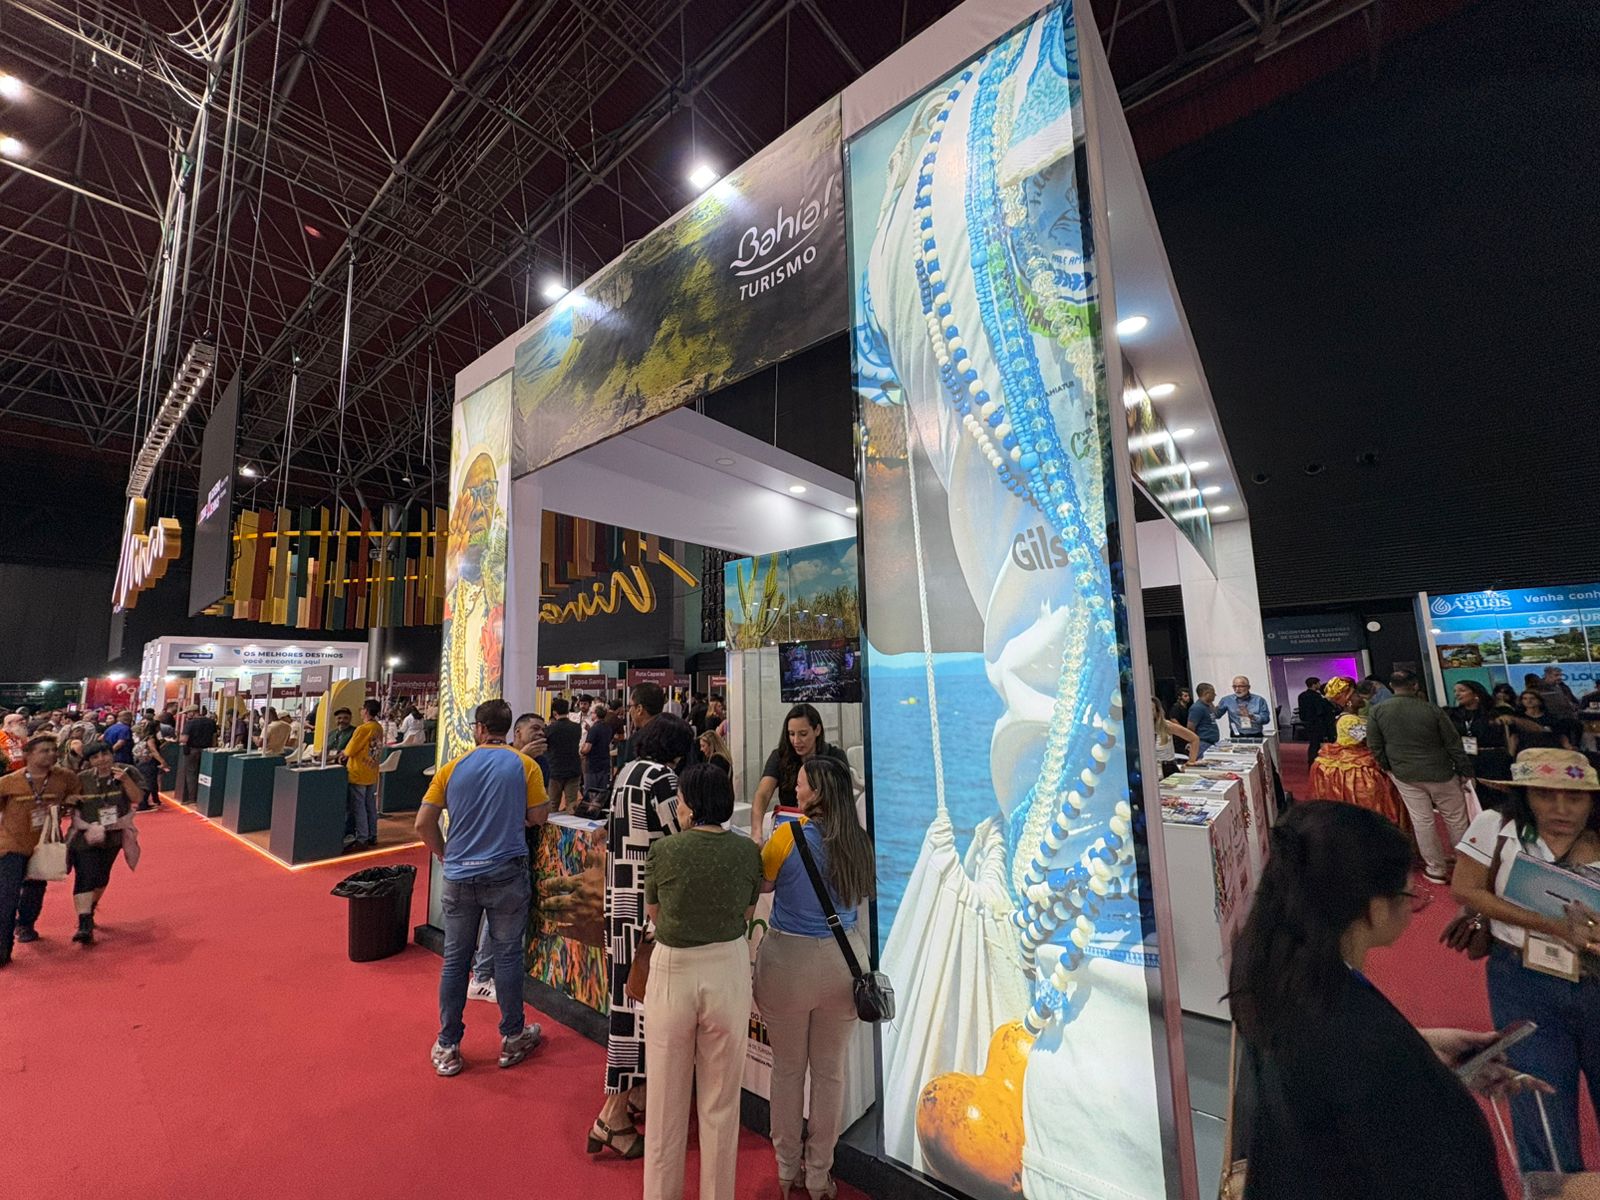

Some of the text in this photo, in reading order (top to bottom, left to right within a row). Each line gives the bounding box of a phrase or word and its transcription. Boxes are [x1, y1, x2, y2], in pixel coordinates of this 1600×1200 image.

[730, 174, 835, 269] Bahia!
[740, 245, 817, 300] TURISMO
[1524, 594, 1564, 603] Venha
[1528, 614, 1558, 625] SÃO
[570, 678, 589, 686] Lagoa
[590, 677, 605, 685] Santa
